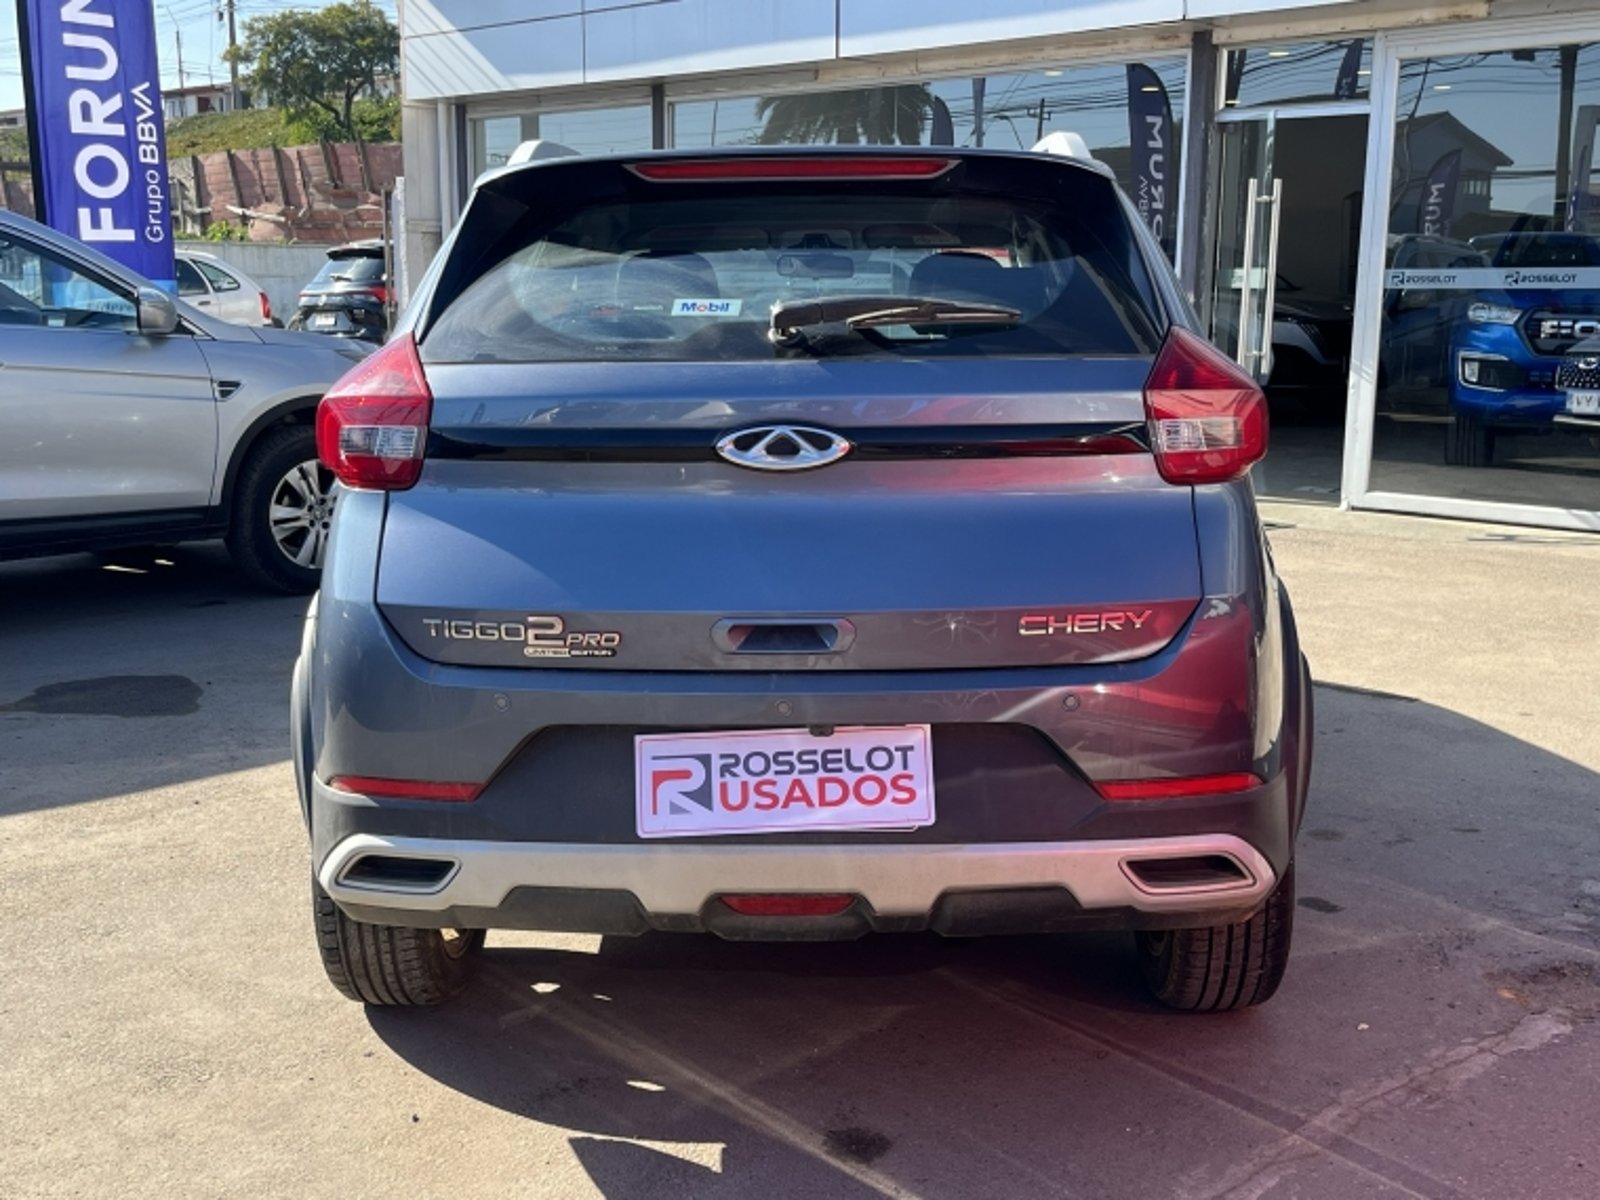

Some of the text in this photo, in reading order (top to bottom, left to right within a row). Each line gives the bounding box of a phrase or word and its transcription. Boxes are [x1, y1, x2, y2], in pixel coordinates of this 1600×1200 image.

[130, 81, 165, 243] Grupo BBVA
[1424, 182, 1445, 236] RUM
[679, 302, 731, 313] Mobil
[422, 617, 526, 642] TIGGO
[566, 631, 621, 647] PRO
[1018, 609, 1153, 636] CHERY
[718, 745, 915, 779] ROSSELOT
[718, 773, 918, 812] USADOS
